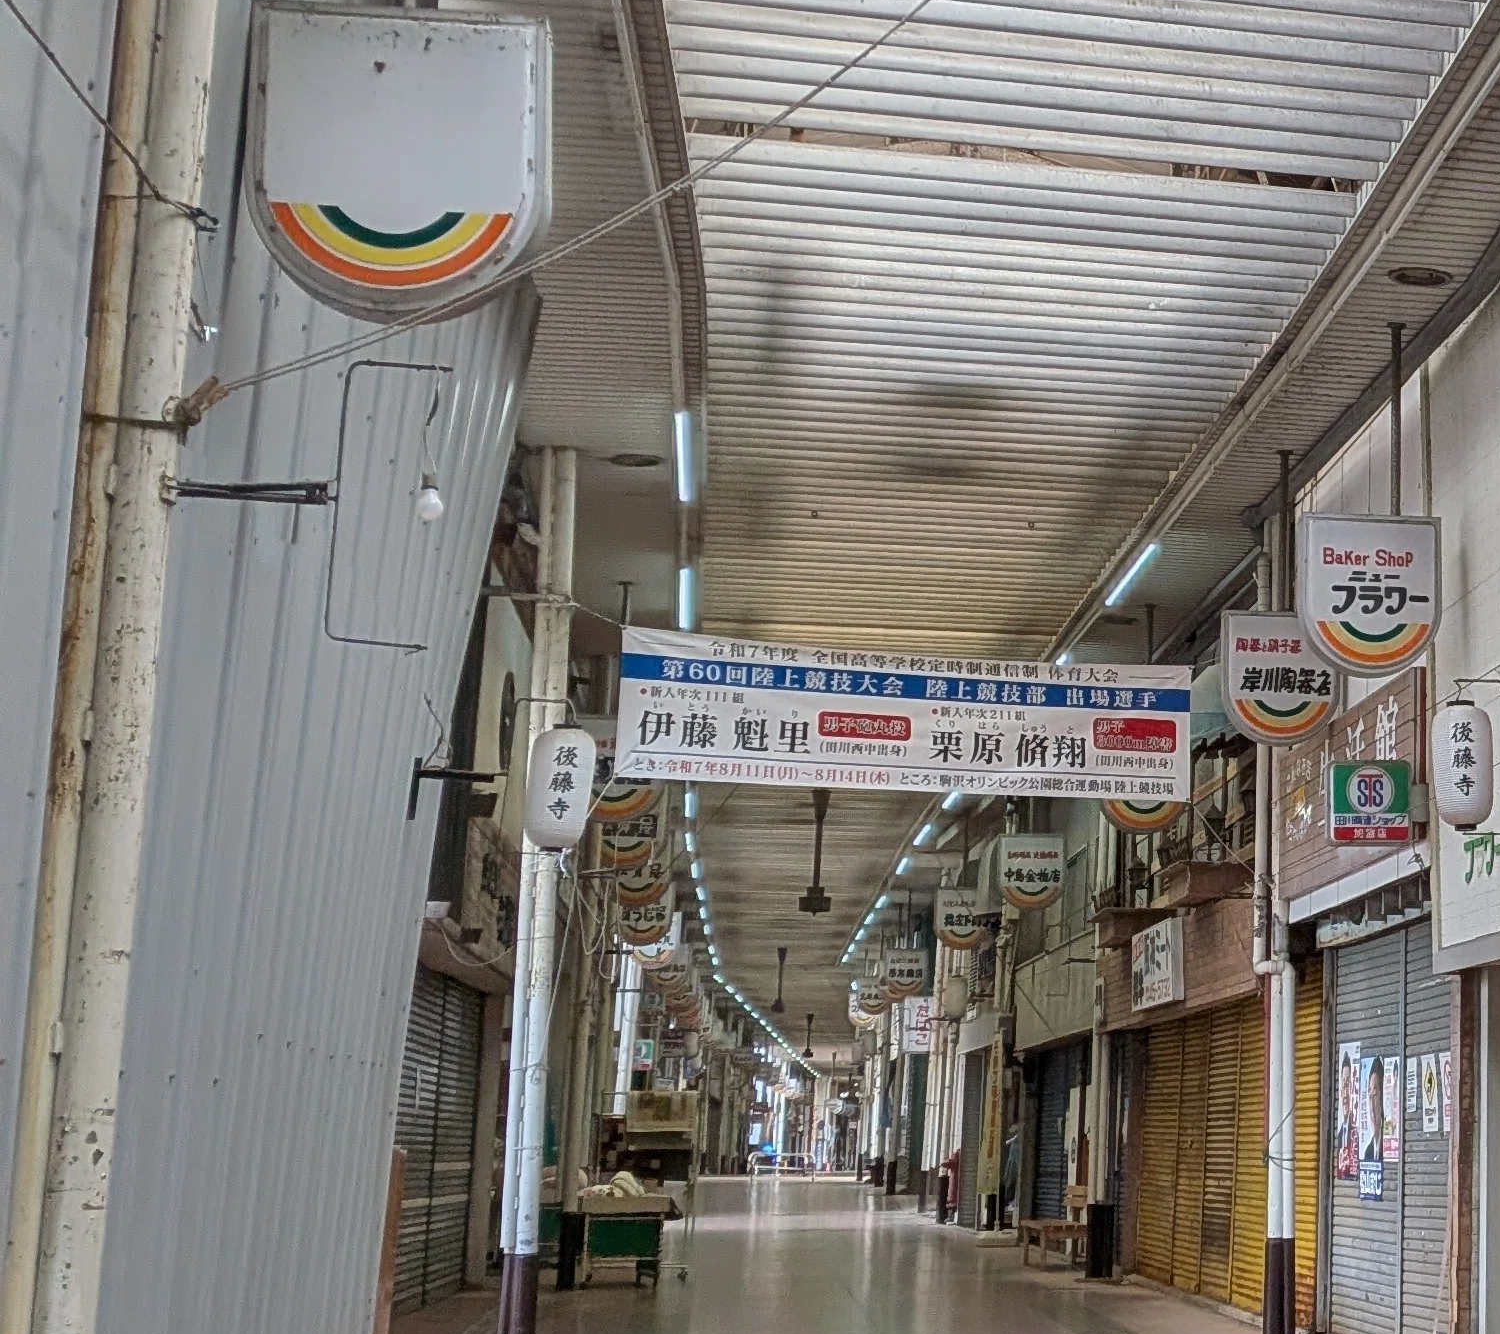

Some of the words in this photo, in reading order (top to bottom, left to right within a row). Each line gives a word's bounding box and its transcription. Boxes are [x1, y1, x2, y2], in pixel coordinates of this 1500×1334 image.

[1331, 585, 1430, 615] フラワー
[661, 659, 904, 696] 第60回陸上競技大会
[925, 678, 1047, 705] 陸上競技部
[1066, 687, 1157, 709] 出場選手
[708, 641, 799, 663] 令和7年度
[811, 649, 1039, 679] 全国高等学校定時制通信制
[1048, 667, 1119, 684] 体育大会
[637, 710, 718, 748] 伊藤
[929, 730, 1005, 765] 栗原
[1449, 720, 1476, 798] 後藤寺
[547, 745, 578, 821] 後藤寺
